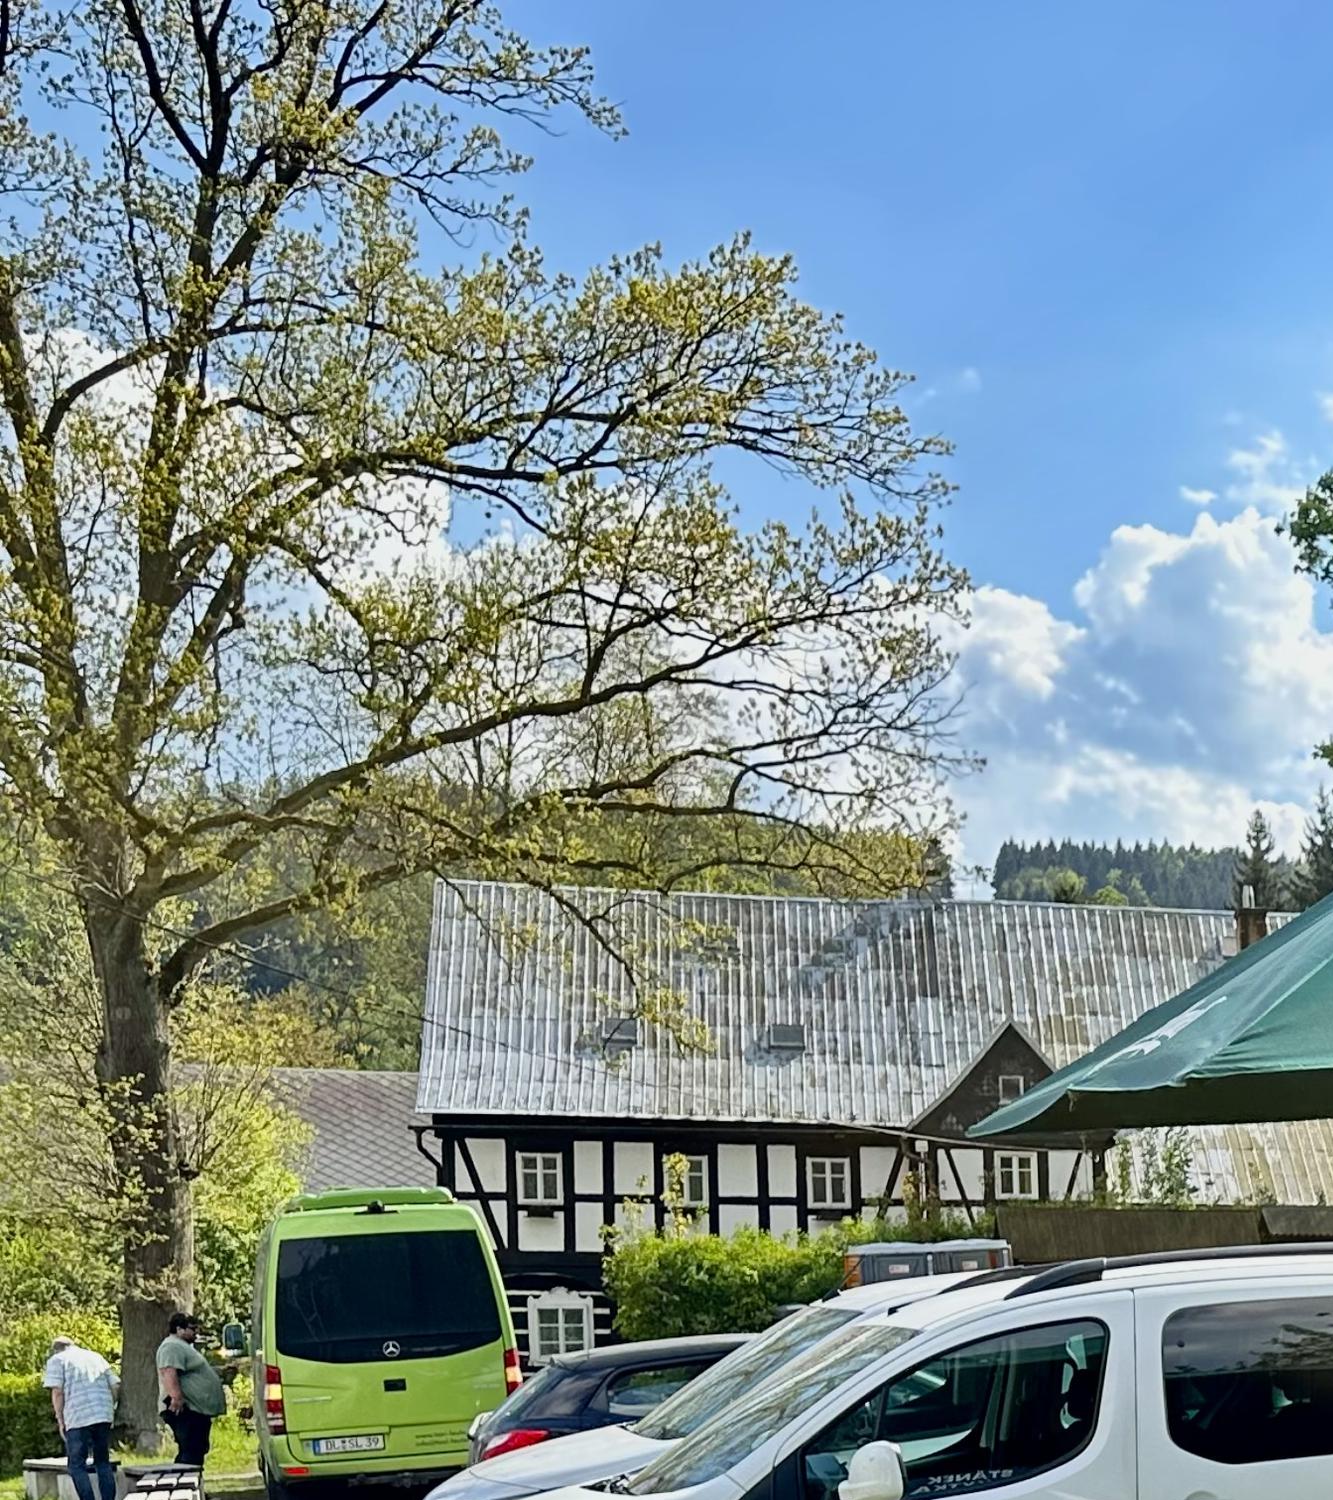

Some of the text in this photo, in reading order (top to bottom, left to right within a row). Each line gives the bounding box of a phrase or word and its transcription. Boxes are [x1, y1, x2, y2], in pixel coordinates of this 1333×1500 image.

[326, 1437, 379, 1450] DL SL 39
